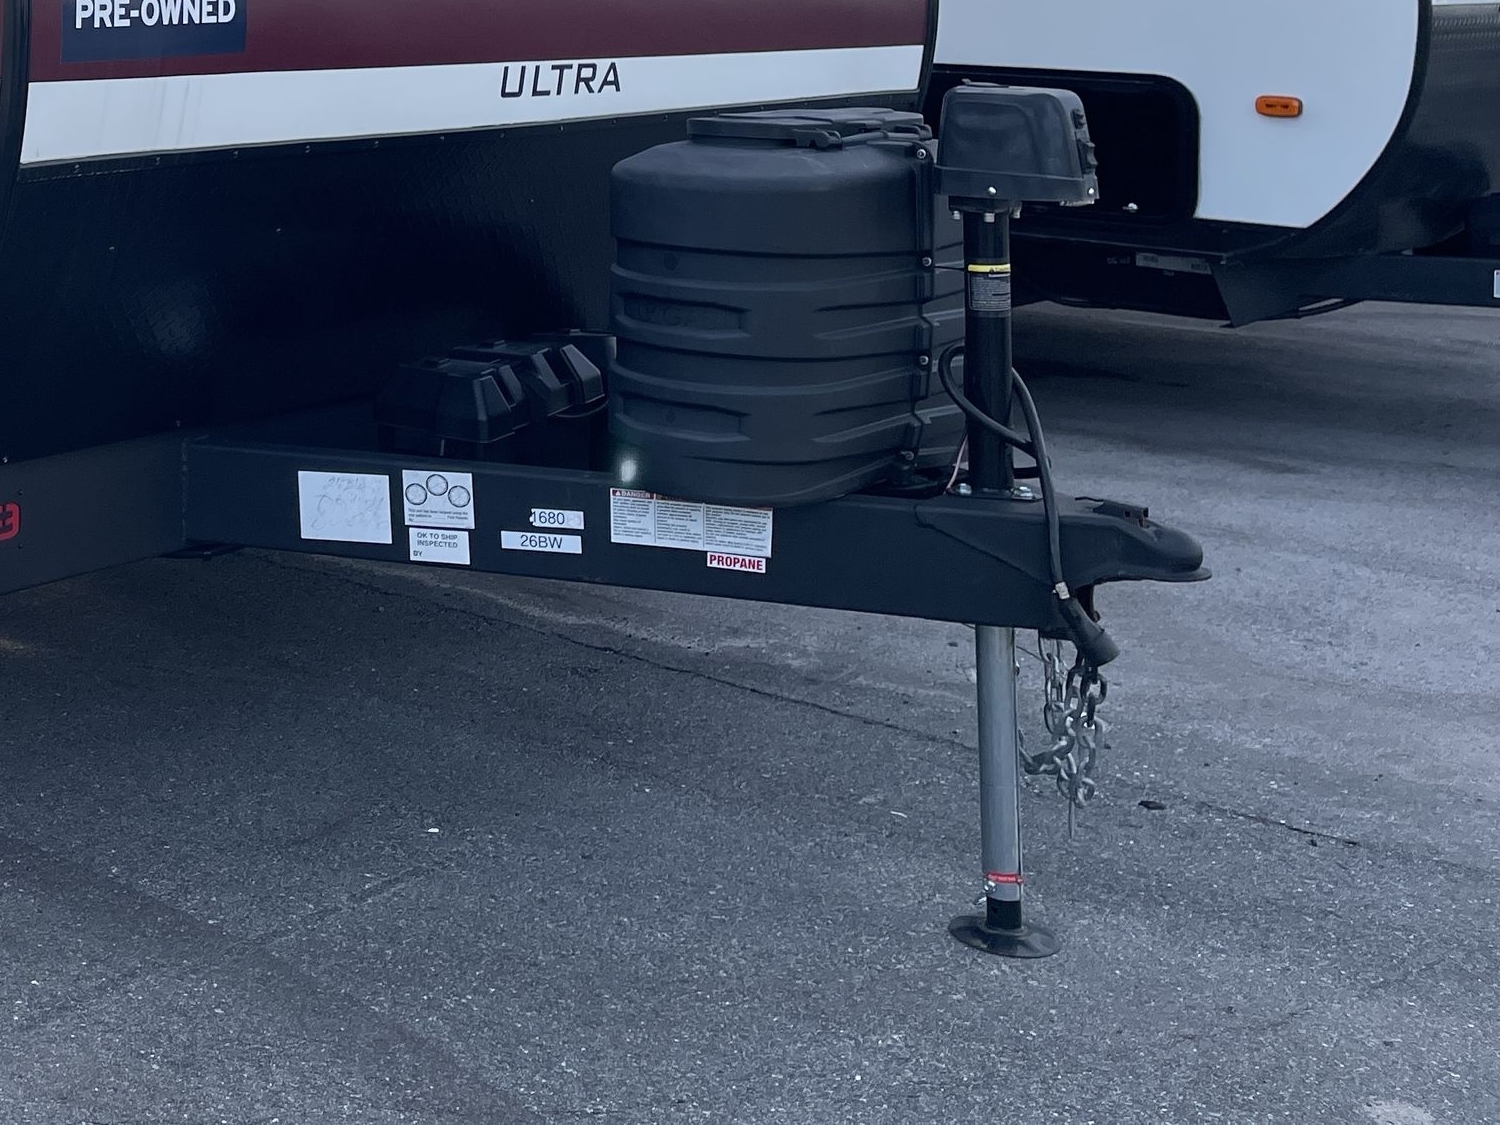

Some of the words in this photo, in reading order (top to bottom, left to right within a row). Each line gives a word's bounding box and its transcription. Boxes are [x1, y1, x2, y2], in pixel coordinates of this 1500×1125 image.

[499, 61, 622, 99] ULTRA
[417, 540, 458, 548] INSPECTED
[441, 533, 458, 541] SHIP
[519, 534, 563, 550] 26BW
[709, 554, 763, 571] PROPANE
